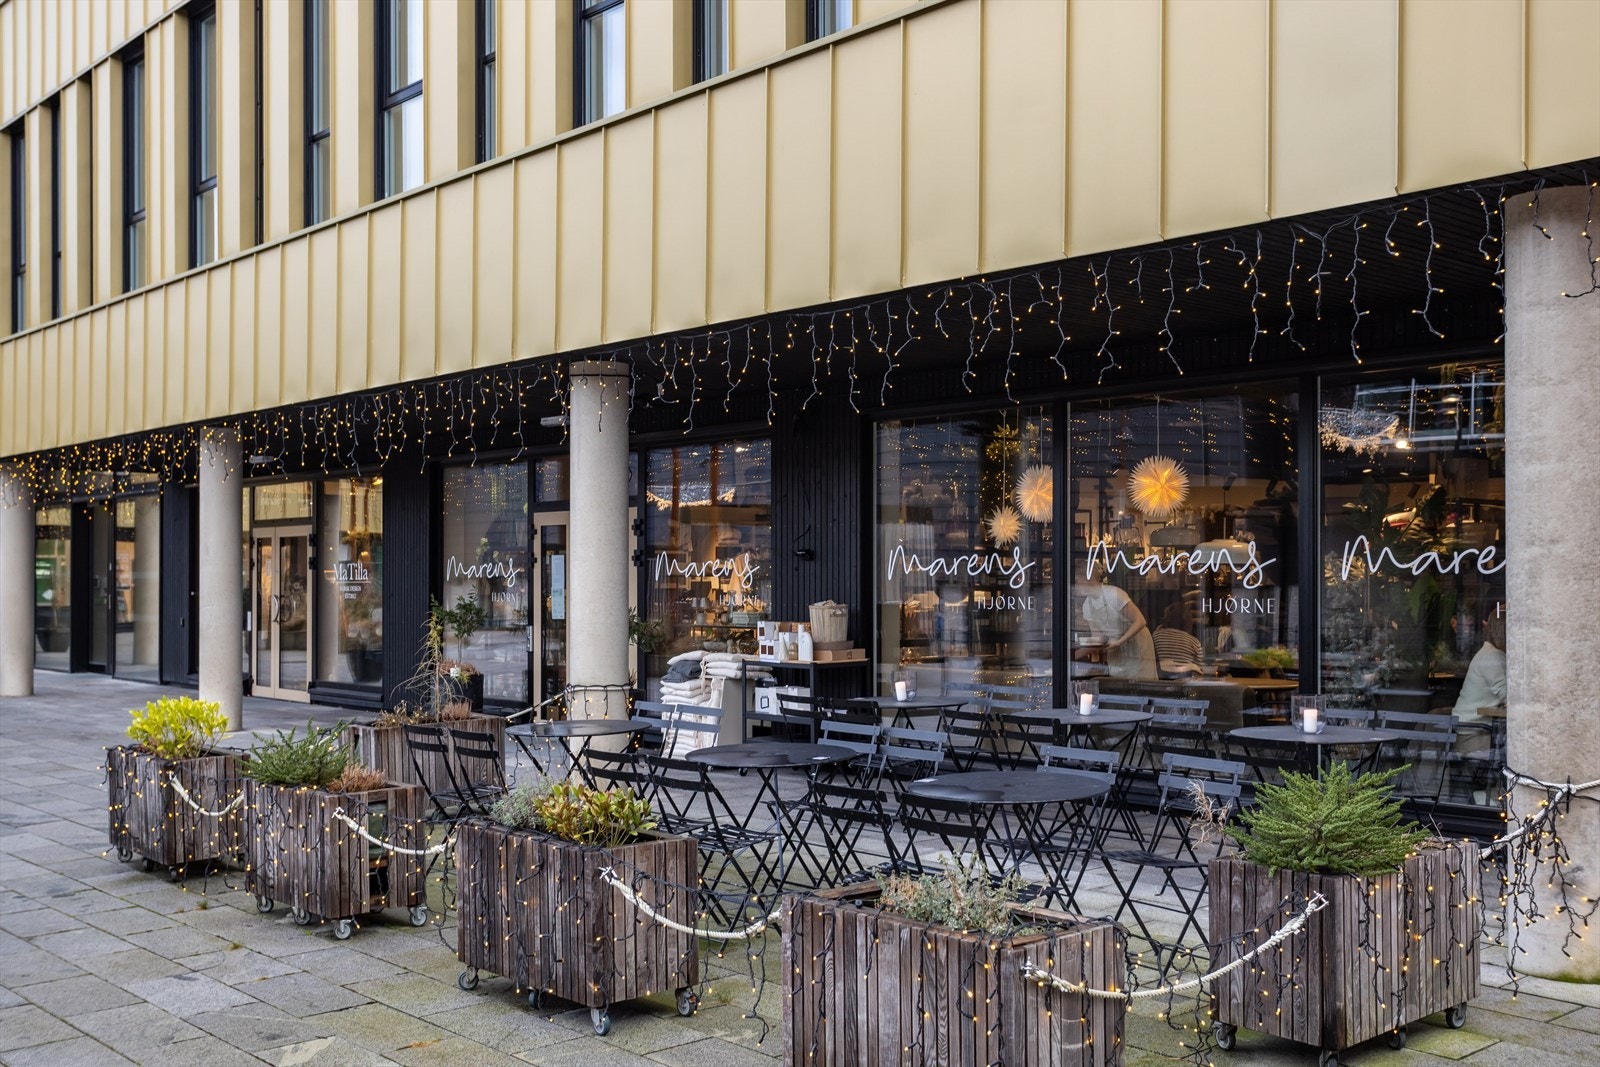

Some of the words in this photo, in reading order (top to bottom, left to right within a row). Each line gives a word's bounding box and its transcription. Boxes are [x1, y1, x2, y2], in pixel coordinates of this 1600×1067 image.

[446, 555, 520, 587] Marens
[655, 551, 760, 588] Marens
[888, 545, 1036, 589] Marens
[1086, 540, 1277, 589] Marens
[1341, 535, 1506, 580] Mare
[977, 594, 1036, 611] HJØRNE
[1202, 597, 1277, 615] HJØRNE
